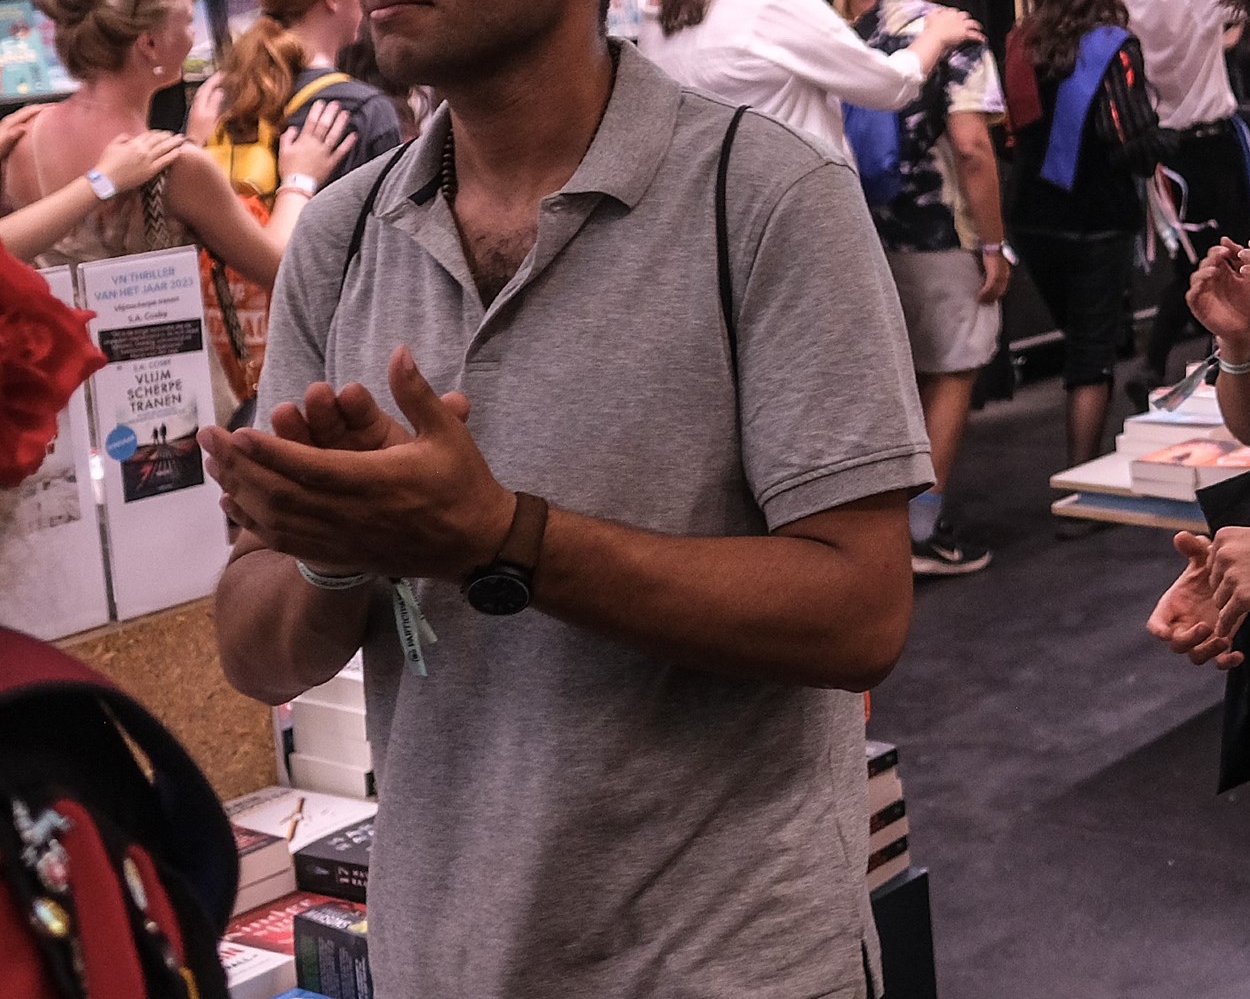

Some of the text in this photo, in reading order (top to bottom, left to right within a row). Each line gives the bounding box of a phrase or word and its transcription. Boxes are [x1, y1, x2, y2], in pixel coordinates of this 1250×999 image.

[94, 290, 117, 301] VAN
[119, 285, 139, 297] HET
[142, 282, 168, 294] JAAR
[135, 369, 171, 384] VLIJM
[127, 379, 182, 401] SCHERPE
[130, 393, 182, 412] TRANEN
